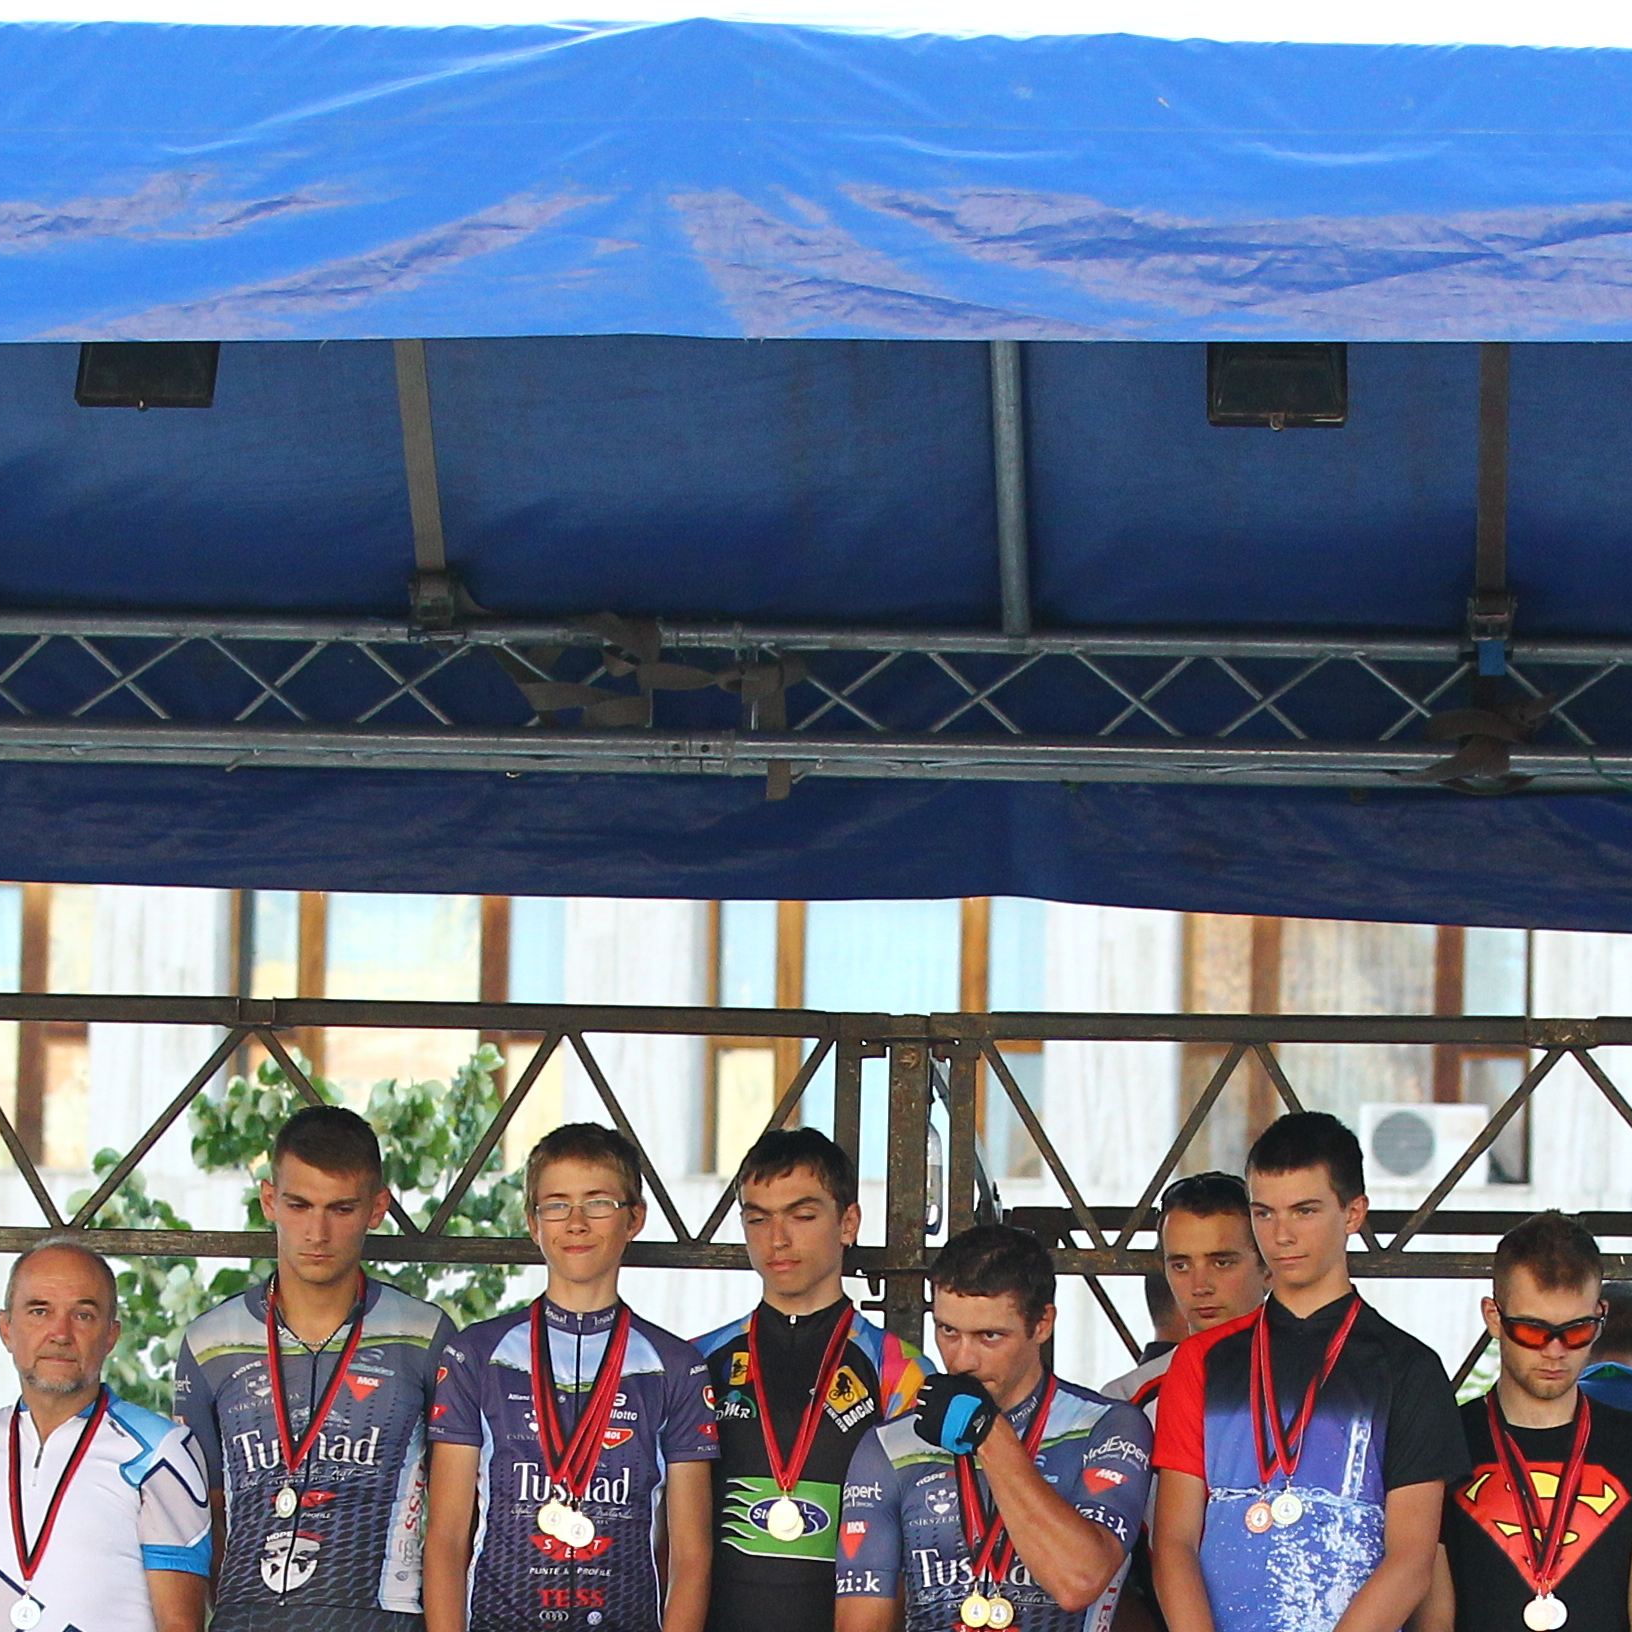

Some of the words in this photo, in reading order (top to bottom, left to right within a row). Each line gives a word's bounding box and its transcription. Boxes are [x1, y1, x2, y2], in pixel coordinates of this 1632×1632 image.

[356, 1376, 380, 1388] MOL
[1096, 1468, 1125, 1485] MOL
[266, 1531, 294, 1542] HOPE
[537, 1587, 607, 1608] TESS
